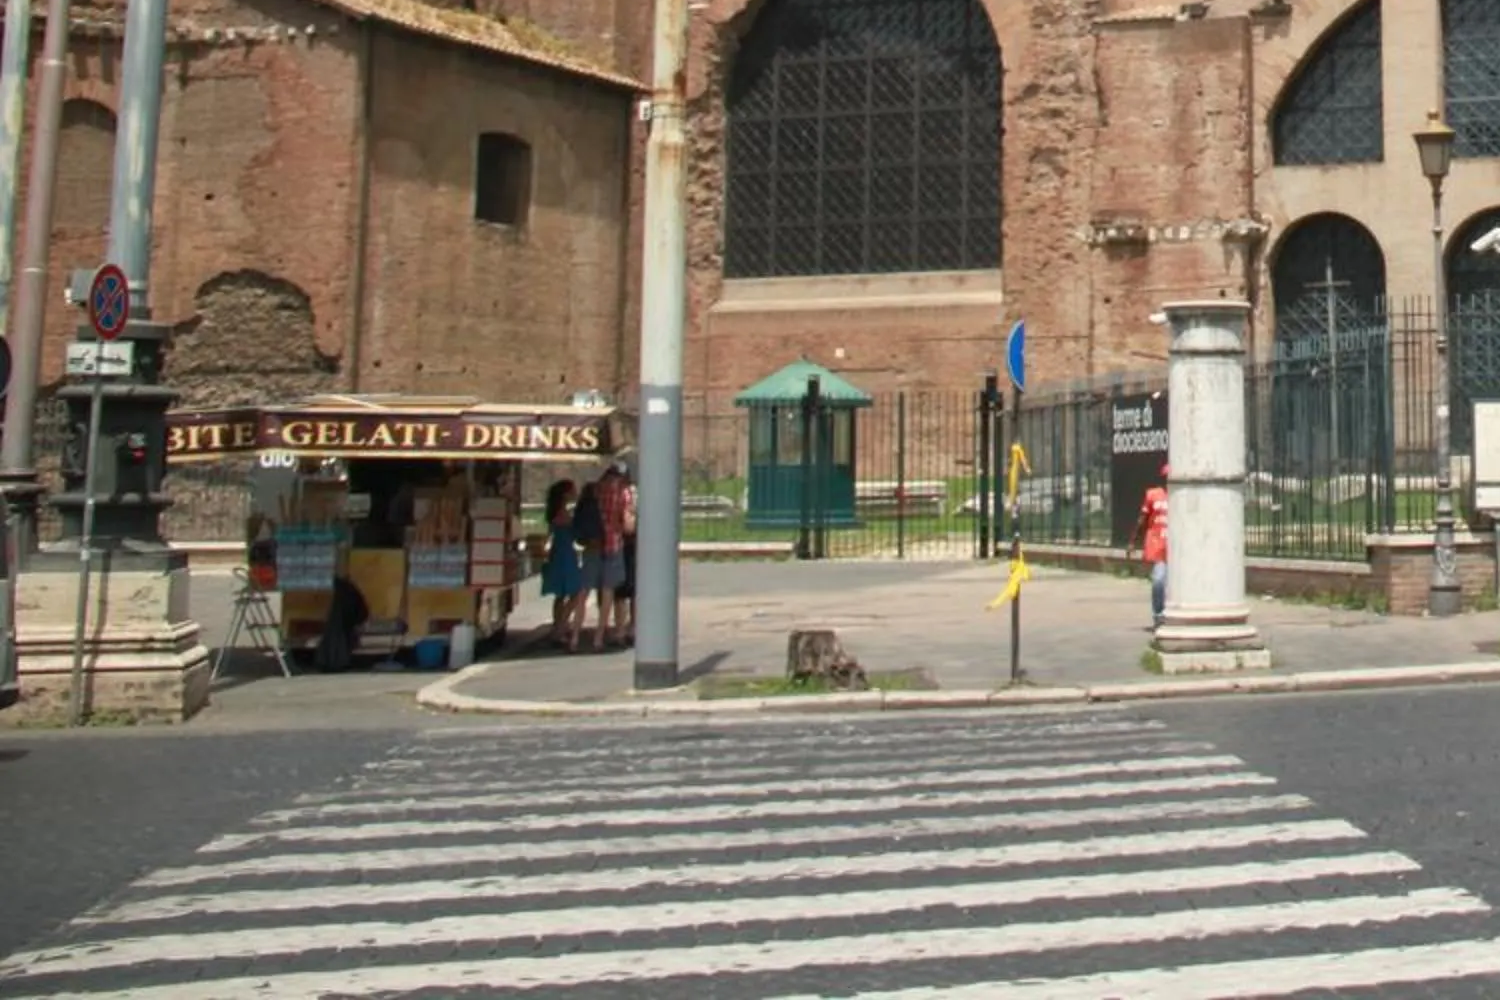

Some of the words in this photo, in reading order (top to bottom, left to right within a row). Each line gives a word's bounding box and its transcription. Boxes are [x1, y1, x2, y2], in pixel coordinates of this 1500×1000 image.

[1113, 403, 1141, 430] terme
[1142, 400, 1153, 428] di
[463, 423, 600, 450] DRINKS
[1112, 429, 1169, 454] diocleziano
